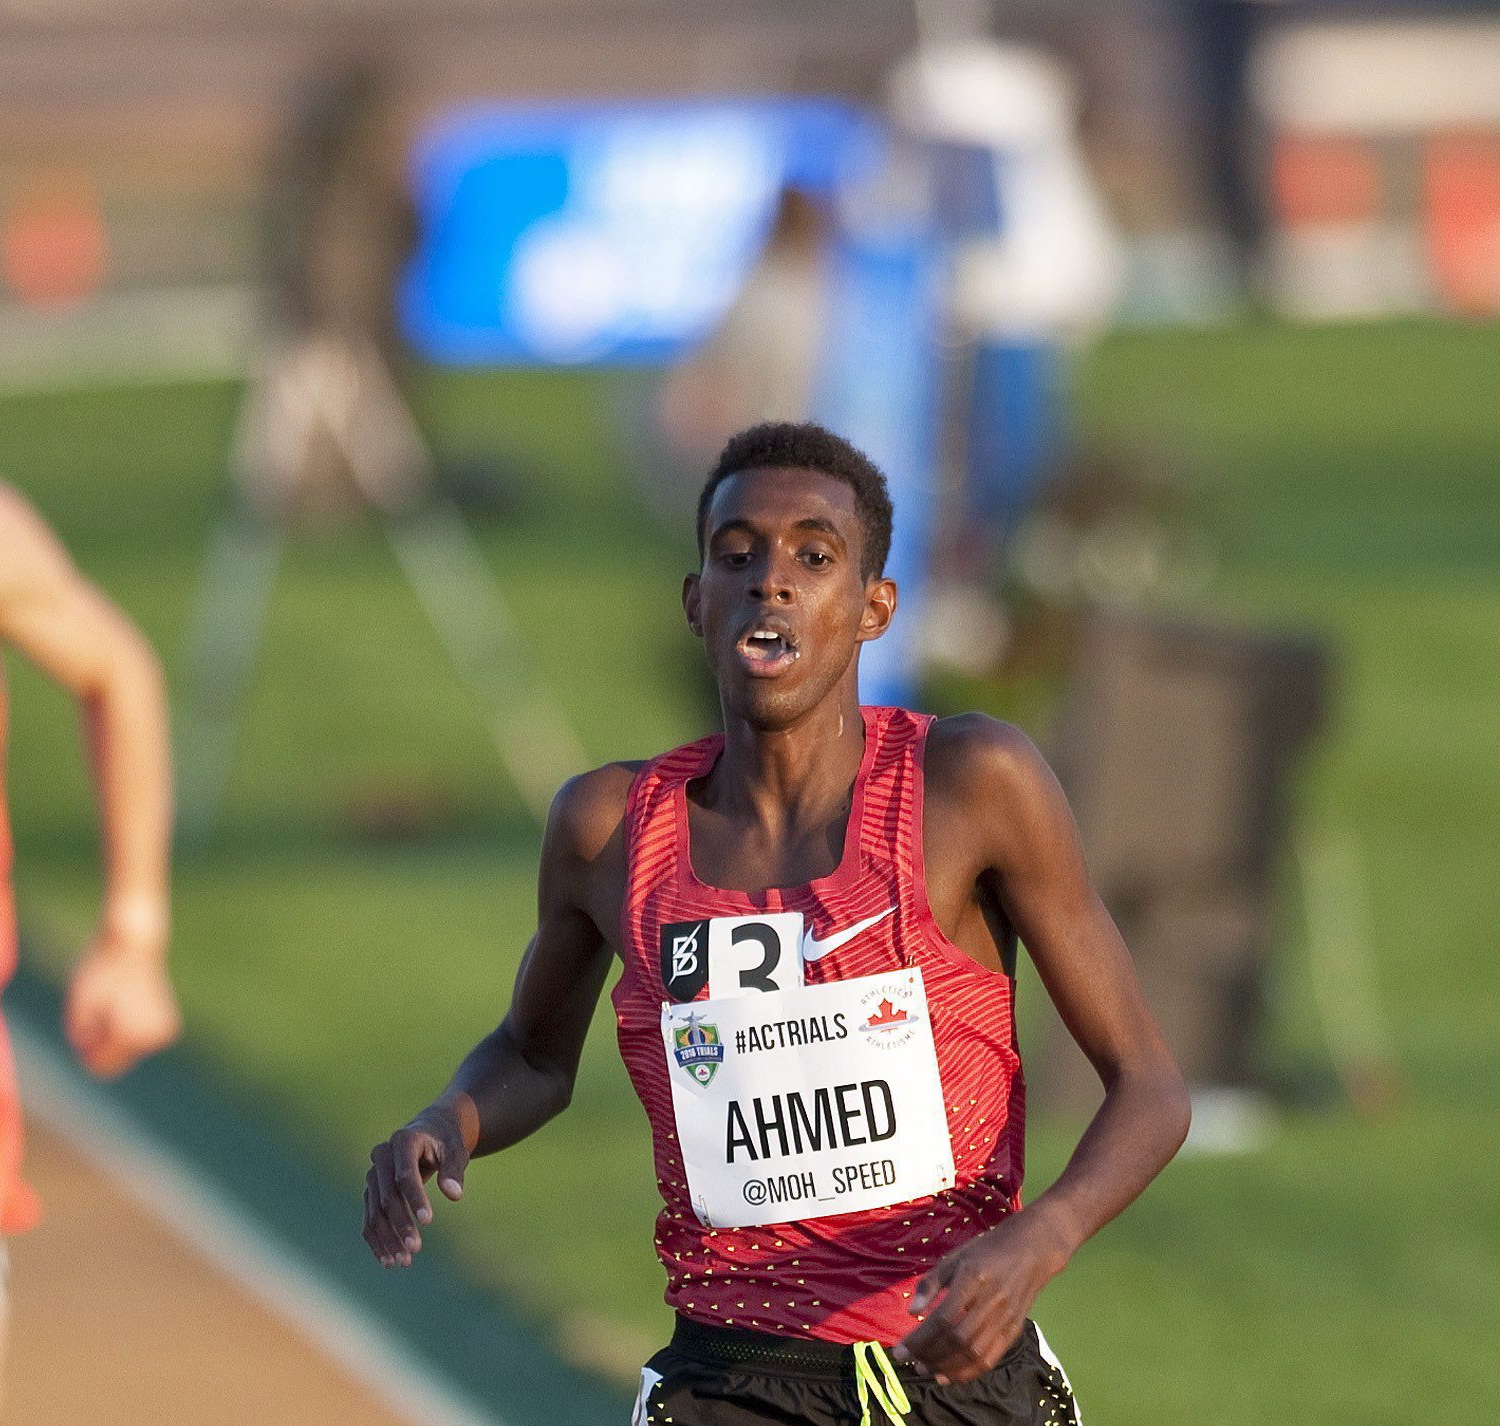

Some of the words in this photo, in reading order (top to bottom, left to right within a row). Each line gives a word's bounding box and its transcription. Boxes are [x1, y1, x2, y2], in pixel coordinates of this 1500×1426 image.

[731, 922, 780, 993] 3
[860, 985, 908, 1006] ATHLETICS
[697, 1046, 719, 1057] TRIALS
[735, 1013, 848, 1054] #ACTRIALS
[726, 1079, 897, 1164] AHMED
[742, 1159, 897, 1206] @MOH_SPEED
